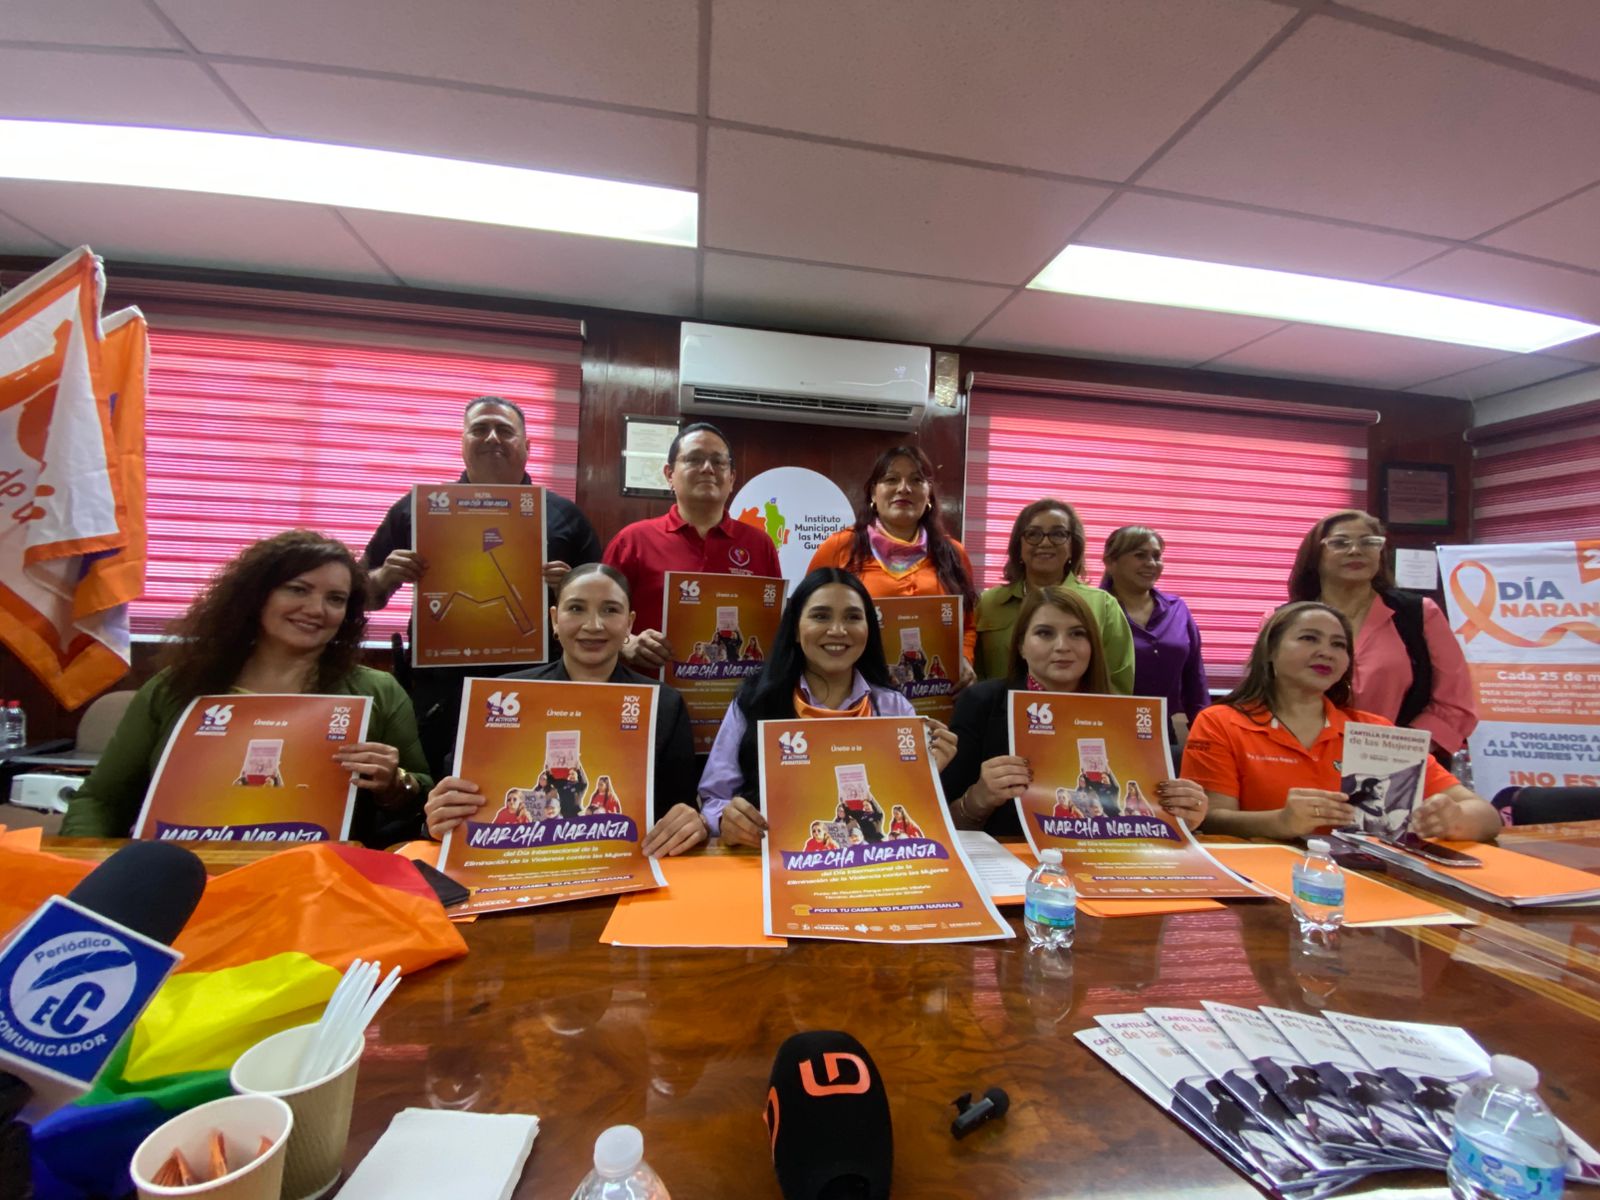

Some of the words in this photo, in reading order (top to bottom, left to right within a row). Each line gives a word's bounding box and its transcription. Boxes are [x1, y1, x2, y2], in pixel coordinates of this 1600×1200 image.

[428, 491, 450, 508] 16
[520, 498, 534, 508] 26
[804, 515, 841, 523] Instituto
[794, 524, 838, 533] Municipal
[798, 533, 811, 541] las
[679, 580, 701, 597] 16
[764, 588, 777, 598] 26
[1497, 576, 1565, 601] DÍA
[941, 607, 953, 617] 26
[675, 662, 719, 678] MARCHA
[1497, 671, 1537, 681] Cada
[1539, 671, 1559, 681] 25
[1563, 671, 1584, 681] de
[911, 683, 953, 697] NARANJA
[487, 691, 521, 717] 16
[621, 702, 641, 717] 26
[1136, 706, 1151, 714] NOV
[205, 704, 235, 726] 16
[546, 708, 569, 717] Únete
[1026, 702, 1054, 724] 16
[329, 713, 351, 728] 26
[1135, 713, 1152, 727] 26
[897, 727, 913, 735] NOV
[1349, 729, 1381, 738] CARTILLA
[1510, 731, 1588, 743] PONGAMOS
[779, 731, 808, 754] 16
[831, 744, 850, 752] Únete
[897, 734, 916, 748] 26
[1349, 737, 1362, 745] de
[1364, 738, 1379, 747] las
[1382, 740, 1425, 752] Mujeres
[1488, 740, 1497, 748] A
[1500, 740, 1518, 749] LA
[1522, 741, 1594, 753] VIOLENCIA
[1483, 748, 1508, 758] LAS
[1512, 750, 1572, 761] MUJERES
[1575, 753, 1585, 762] Y
[469, 820, 547, 847] MARCHA
[552, 819, 630, 842] NARANJA
[1044, 817, 1101, 838] MARCHA
[1105, 820, 1170, 838] NARANJA
[787, 847, 855, 870] MARCHA
[863, 843, 937, 863] NARANJA
[34, 937, 112, 963] Periódico
[1172, 1022, 1192, 1032] de
[1192, 1022, 1218, 1033] las
[1121, 1030, 1141, 1040] de
